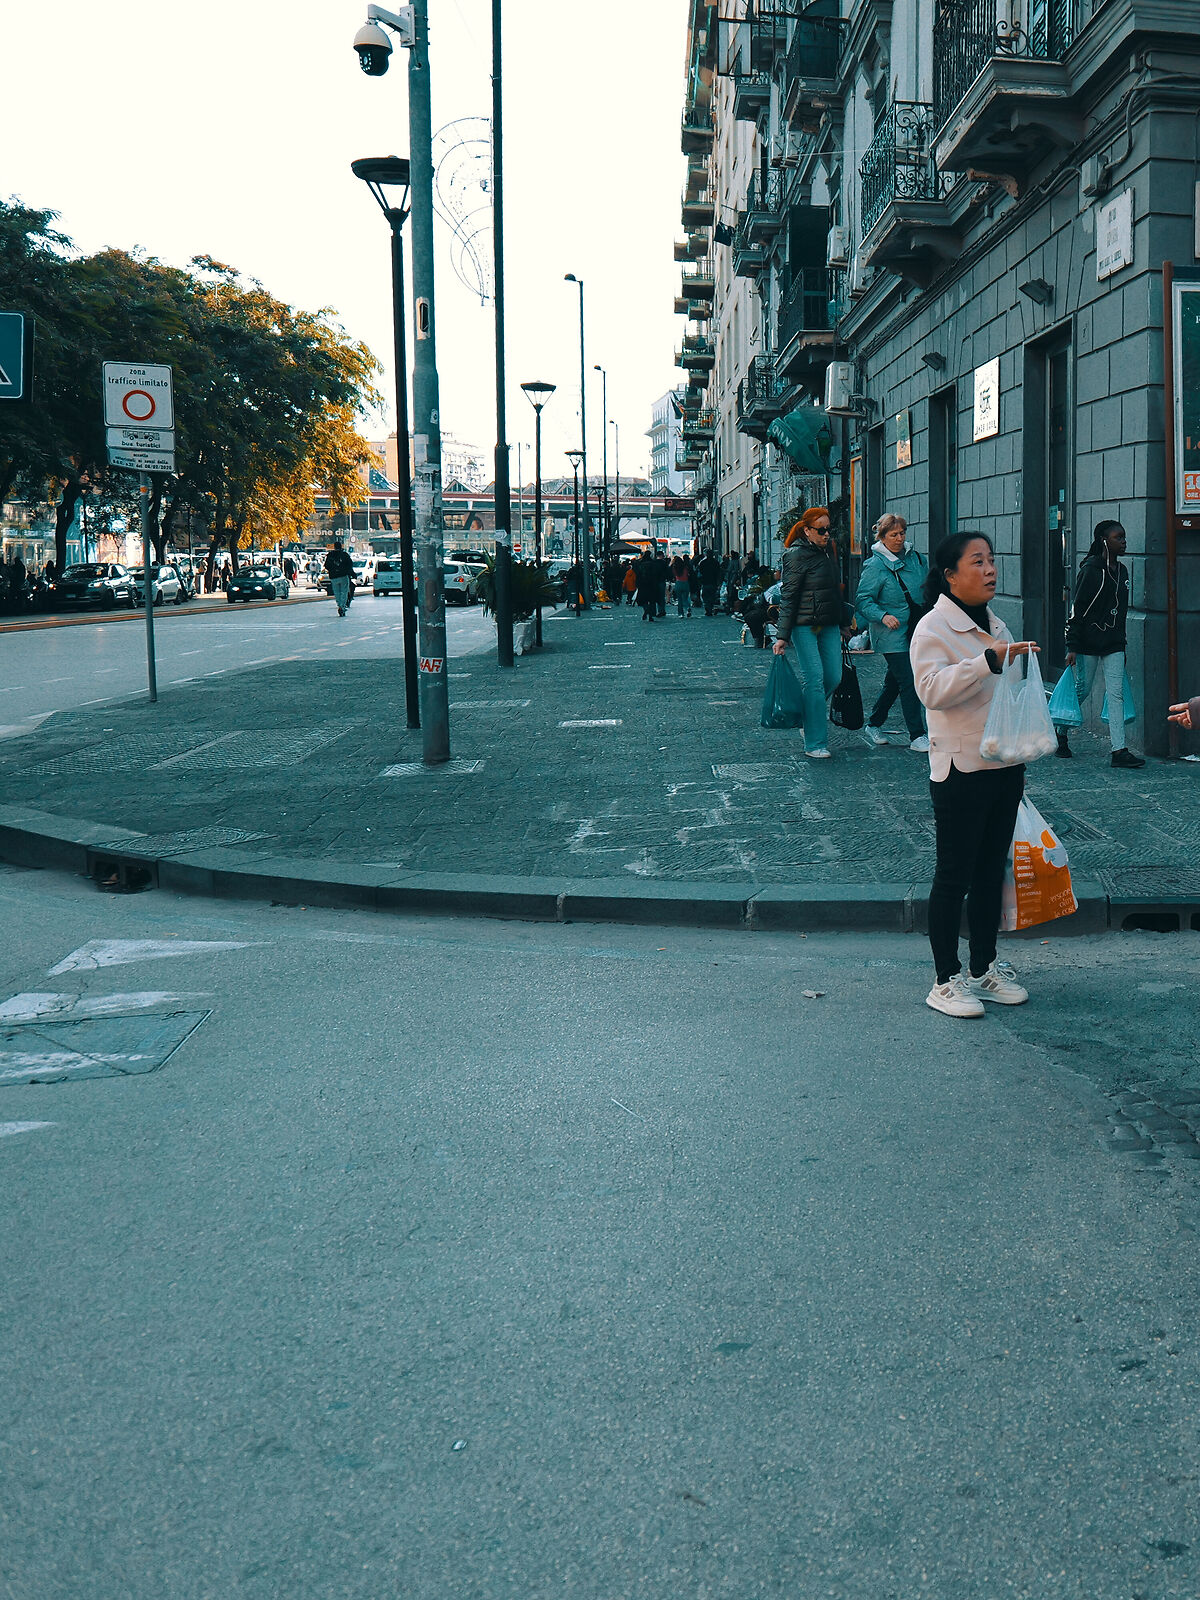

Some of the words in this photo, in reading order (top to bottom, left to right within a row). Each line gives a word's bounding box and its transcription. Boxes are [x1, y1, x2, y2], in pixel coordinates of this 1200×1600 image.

[129, 368, 146, 376] zona
[108, 376, 137, 385] traffico
[138, 378, 169, 388] limitato
[135, 441, 161, 449] turistici
